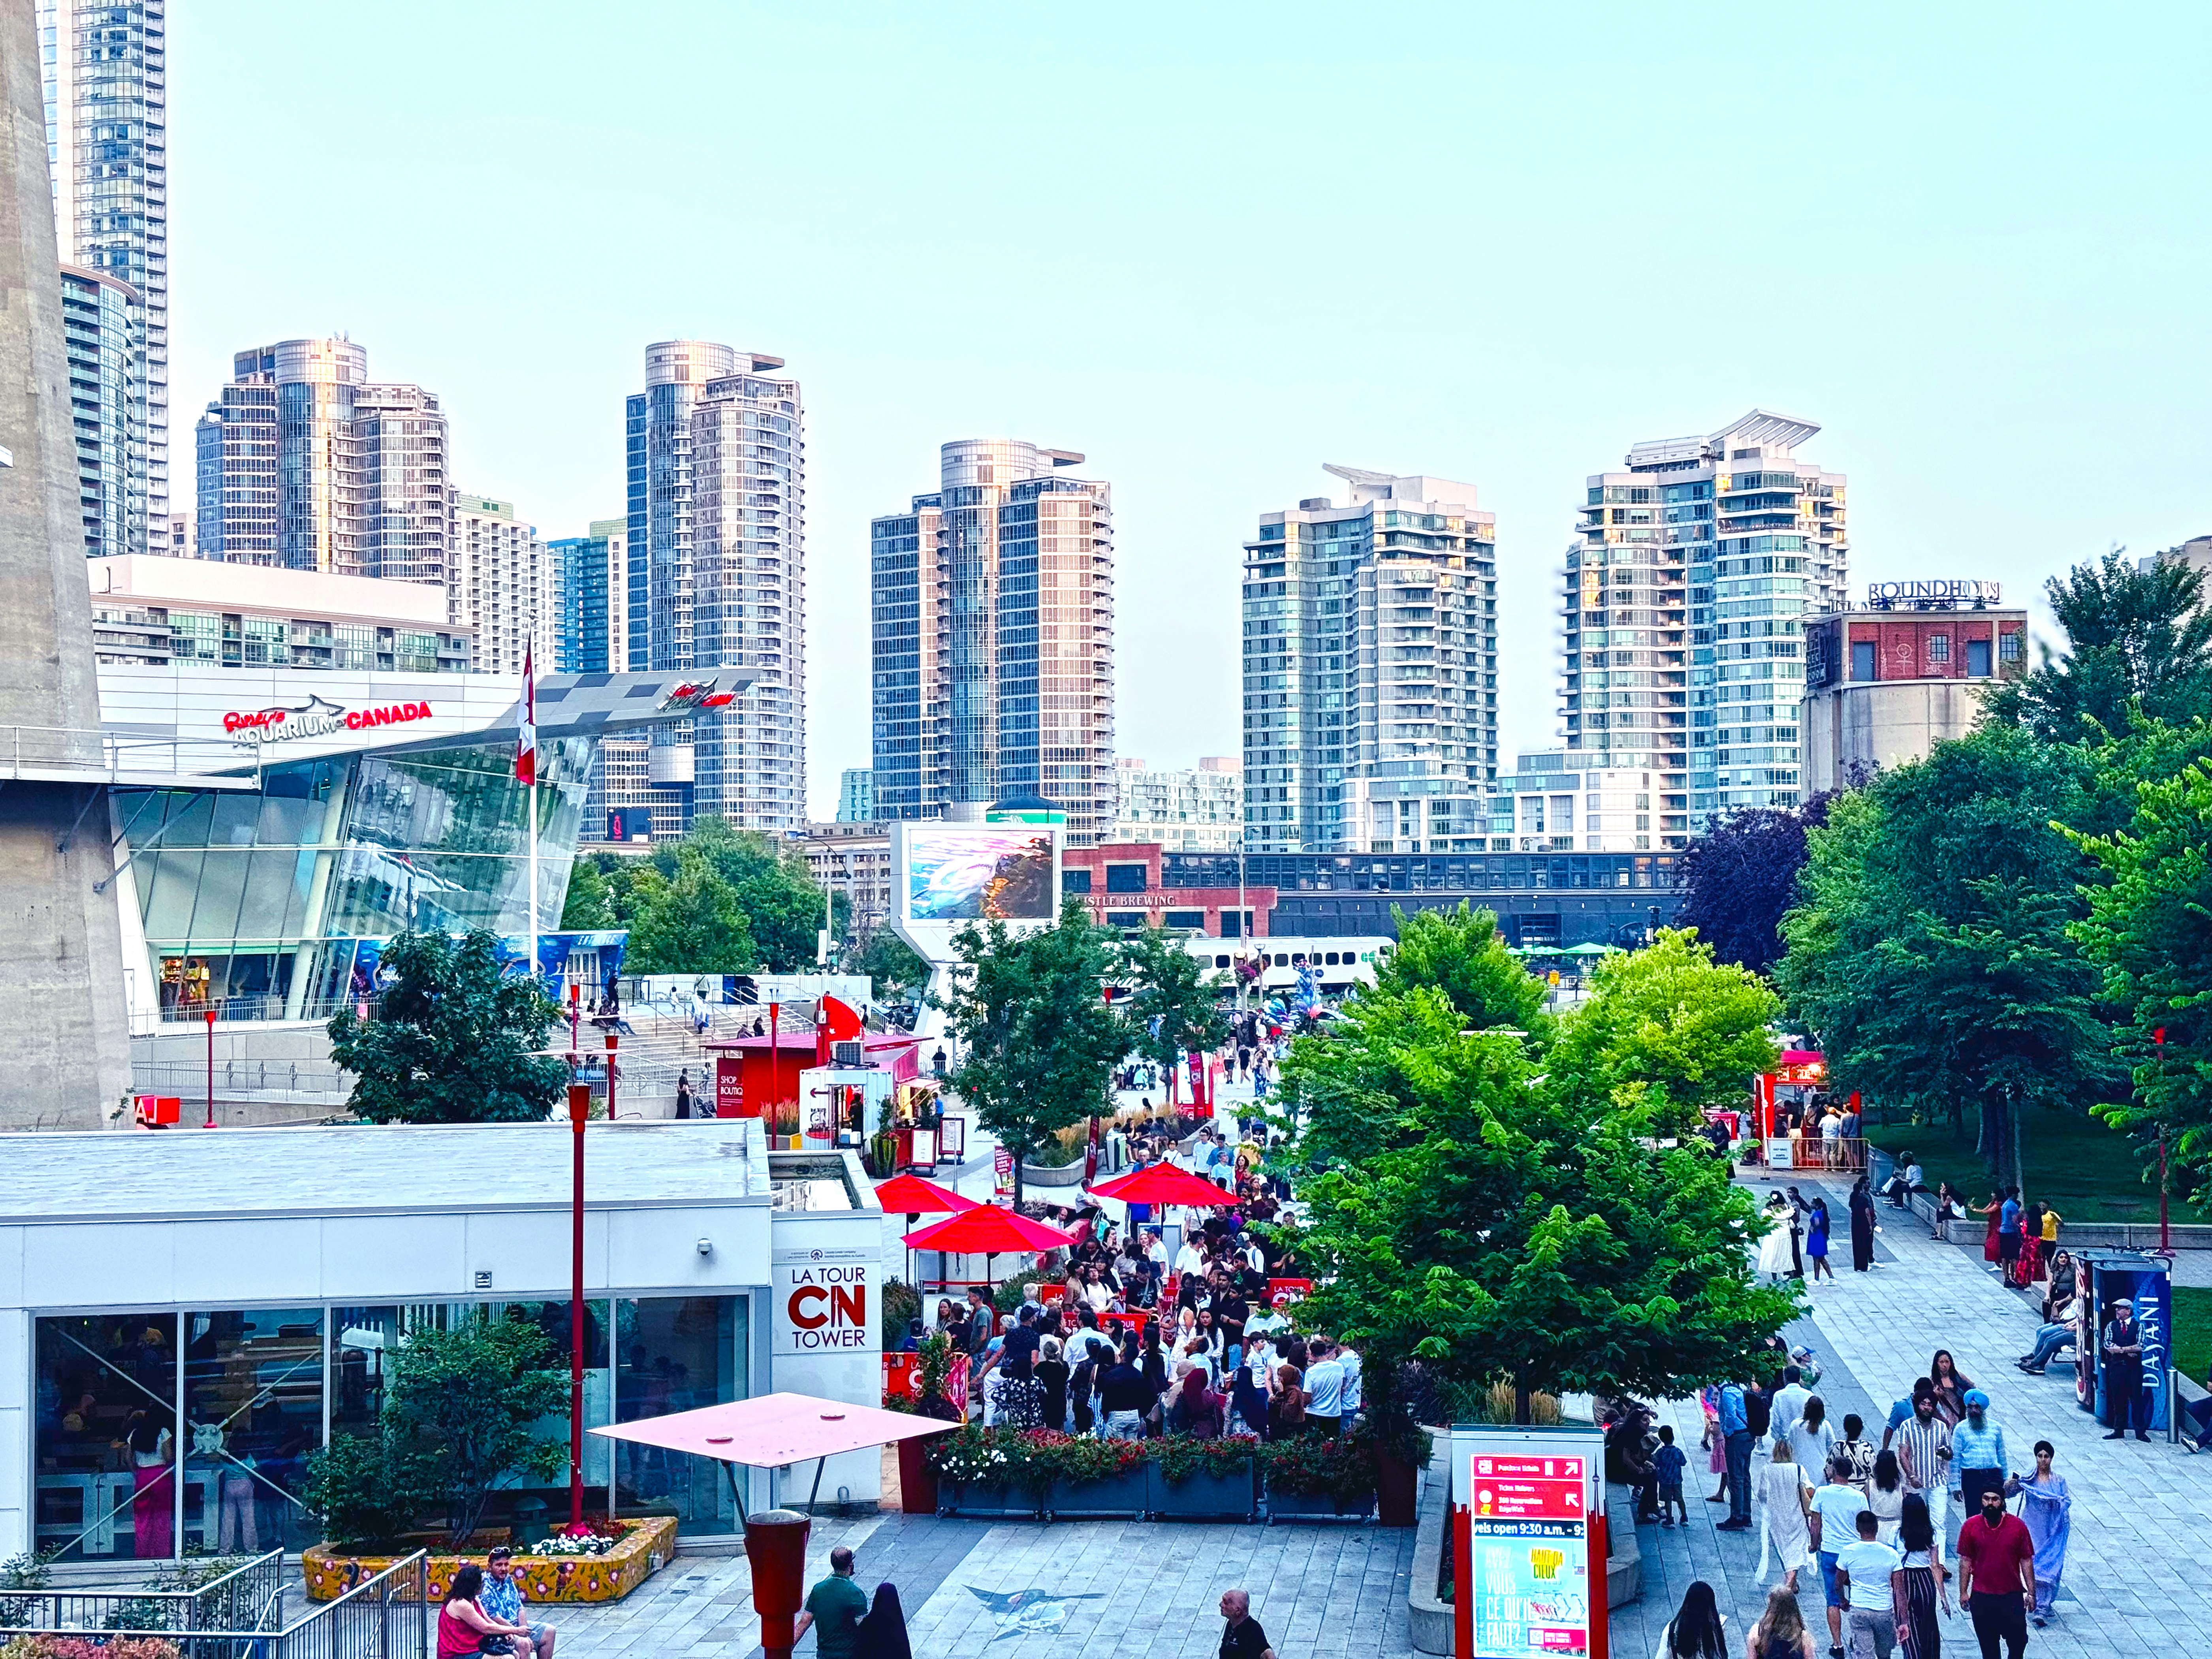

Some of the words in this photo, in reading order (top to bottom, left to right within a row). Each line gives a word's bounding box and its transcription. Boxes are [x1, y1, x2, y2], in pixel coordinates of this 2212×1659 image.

[1869, 579, 2000, 601] ROUNDHOUS
[233, 715, 337, 748] AQUARIUM
[346, 701, 432, 730] CANADA
[1120, 895, 1176, 906] BREWING
[720, 1076, 737, 1084] SHOP
[792, 1269, 814, 1284] LA
[818, 1267, 865, 1283] TOUR
[788, 1285, 865, 1330] CN
[792, 1330, 865, 1349] TOWER
[2139, 1297, 2165, 1387] DASANI
[1493, 1525, 1518, 1535] open
[1520, 1523, 1542, 1535] 9:30
[1544, 1525, 1565, 1536] a.m.
[1533, 1564, 1556, 1579] CIEUX
[1486, 1571, 1516, 1595] VOUS
[1486, 1597, 1500, 1620] CE
[1505, 1598, 1535, 1621] QU'IL
[1487, 1621, 1520, 1647] FAUT?
